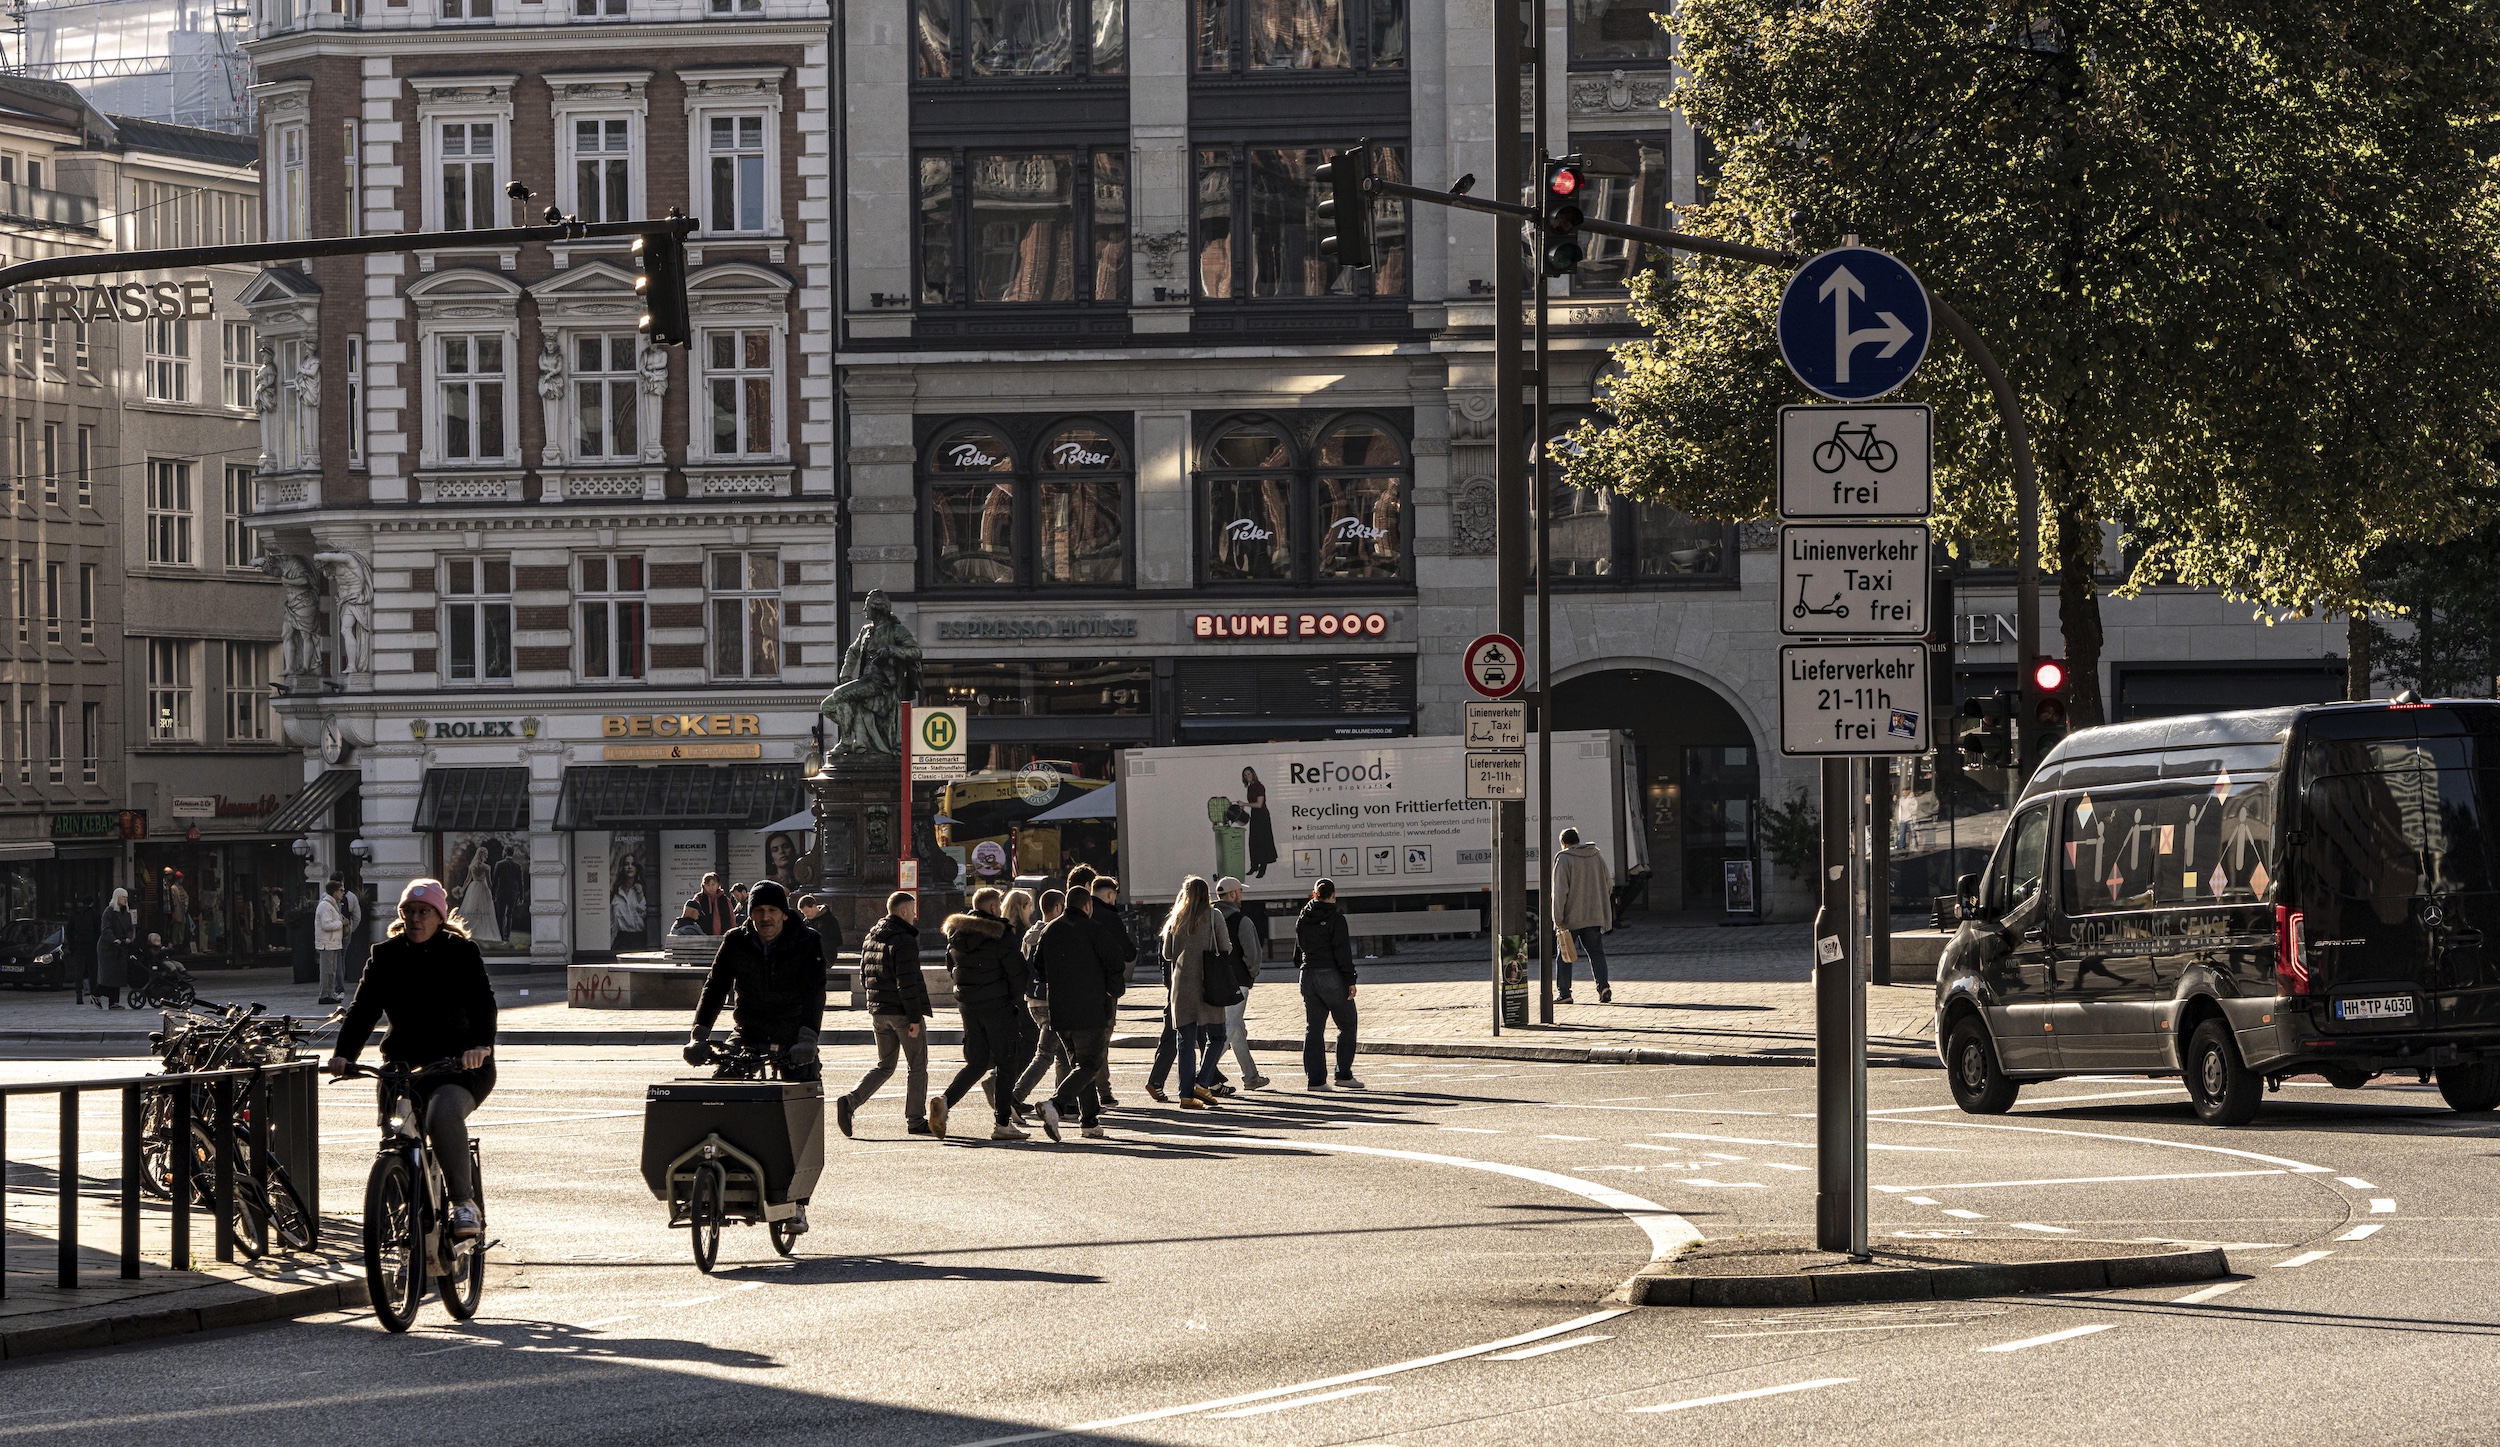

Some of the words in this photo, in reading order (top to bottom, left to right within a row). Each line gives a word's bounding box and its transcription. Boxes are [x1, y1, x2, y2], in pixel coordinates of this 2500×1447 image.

[948, 443, 1000, 466] Peter
[1052, 442, 1111, 466] Polzer
[1833, 481, 1879, 504] frei
[1225, 518, 1273, 541] Peter
[1331, 516, 1388, 540] Polzer
[1792, 539, 1918, 561] Linienverkehr
[1843, 569, 1893, 591] Taxi
[1870, 599, 1912, 621] frei
[936, 620, 1052, 639] ESPRESSO
[1055, 618, 1137, 638] HOUSE
[1195, 613, 1290, 638] BLUME
[1298, 612, 1387, 637] 2000
[1791, 658, 1915, 681] Lieferverkehr
[1817, 688, 1891, 711] 21-11h
[160, 718, 173, 728] SPOT
[1469, 708, 1521, 717] Linienverkehr
[435, 721, 515, 738] ROLEX
[602, 714, 760, 738] BECKER
[1491, 721, 1511, 730] Taxi
[1834, 719, 1876, 740] frei
[1502, 733, 1519, 742] frei
[671, 745, 681, 758] &
[687, 746, 756, 756] UHRMACHER
[1019, 764, 1057, 779] ESPRESSO
[1290, 758, 1383, 784] ReFood
[1470, 759, 1521, 768] Lieferverkehr
[1481, 771, 1511, 781] 21-11h
[1024, 793, 1053, 804] HOUSE
[1487, 785, 1505, 794] frei
[1291, 803, 1359, 820] Recycling
[1364, 804, 1390, 815] von
[1396, 799, 1491, 814] Frittierfetten.
[55, 815, 80, 833] ARIN
[1306, 822, 1350, 831] Einsammlung
[1366, 821, 1405, 829] Verwertung
[1420, 819, 1460, 828] Speiseresten
[1331, 830, 1402, 839] Lebensmittelindustrie.
[1407, 828, 1461, 836] www.refood.de
[1460, 853, 1474, 861] Tel.
[2070, 920, 2106, 950] STOP
[2112, 918, 2171, 948] MAKING
[2180, 915, 2232, 946] SENSE
[2314, 938, 2366, 947] SPRINTER
[575, 973, 622, 1007] NPC
[2344, 1001, 2359, 1015] HH
[2367, 1000, 2381, 1013] TP
[2384, 998, 2412, 1012] 4030
